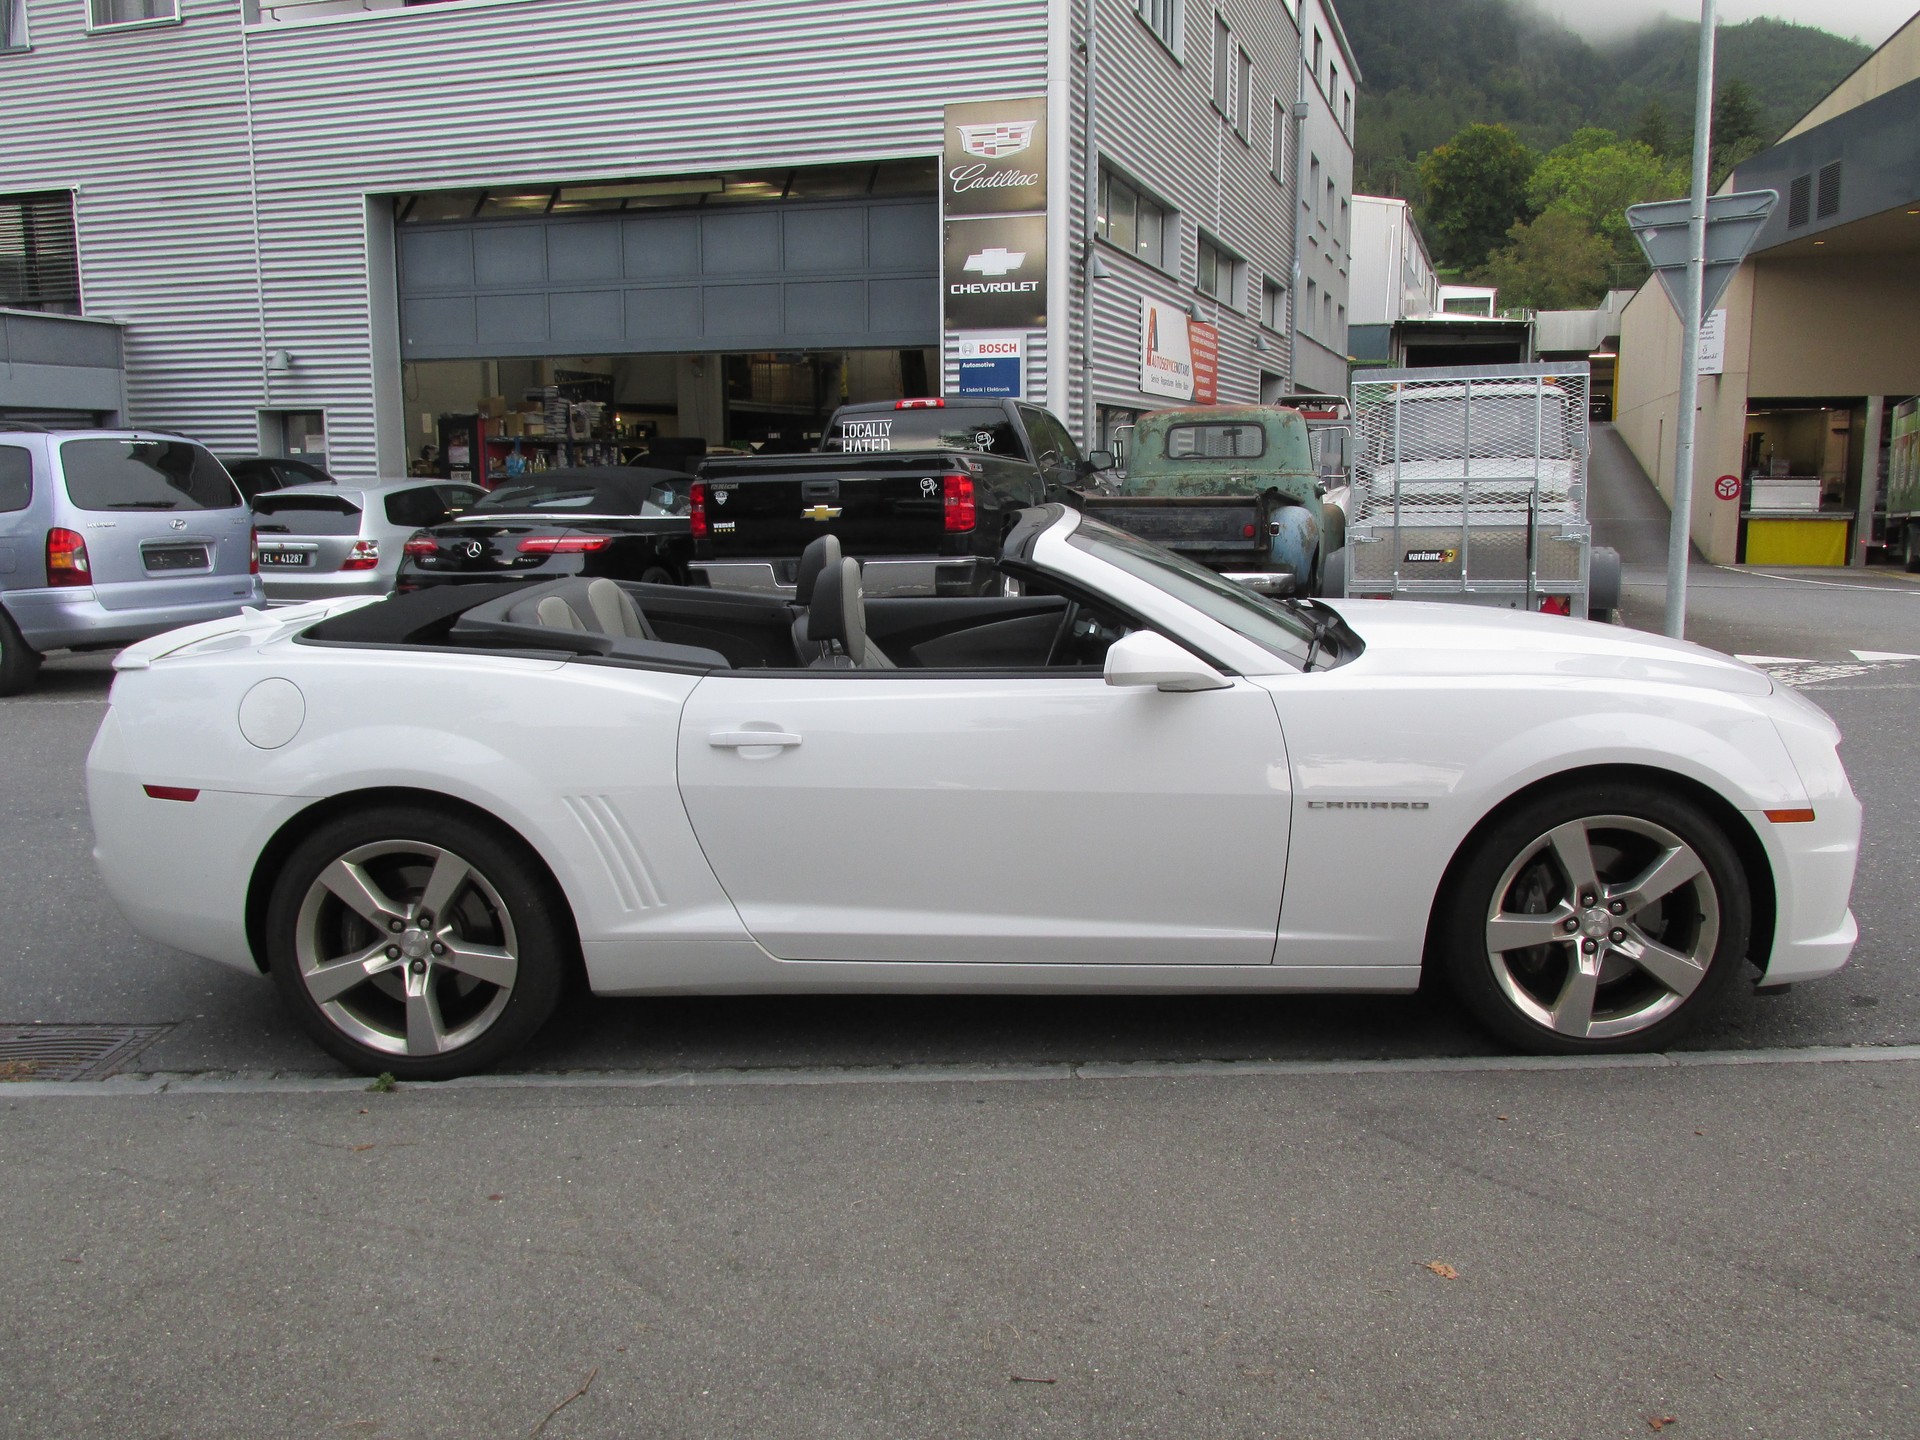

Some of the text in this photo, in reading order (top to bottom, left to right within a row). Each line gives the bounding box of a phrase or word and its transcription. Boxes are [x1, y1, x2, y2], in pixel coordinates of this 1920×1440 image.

[949, 163, 1039, 193] Cadillac
[950, 281, 1039, 295] CHEVROLET
[978, 343, 1017, 354] BOSCH
[962, 361, 995, 369] Automotive
[842, 422, 892, 439] LOCALLY
[842, 438, 891, 453] HATED
[263, 553, 304, 564] FL 41287
[1408, 551, 1441, 561] variant
[1307, 801, 1430, 809] CAMARO
